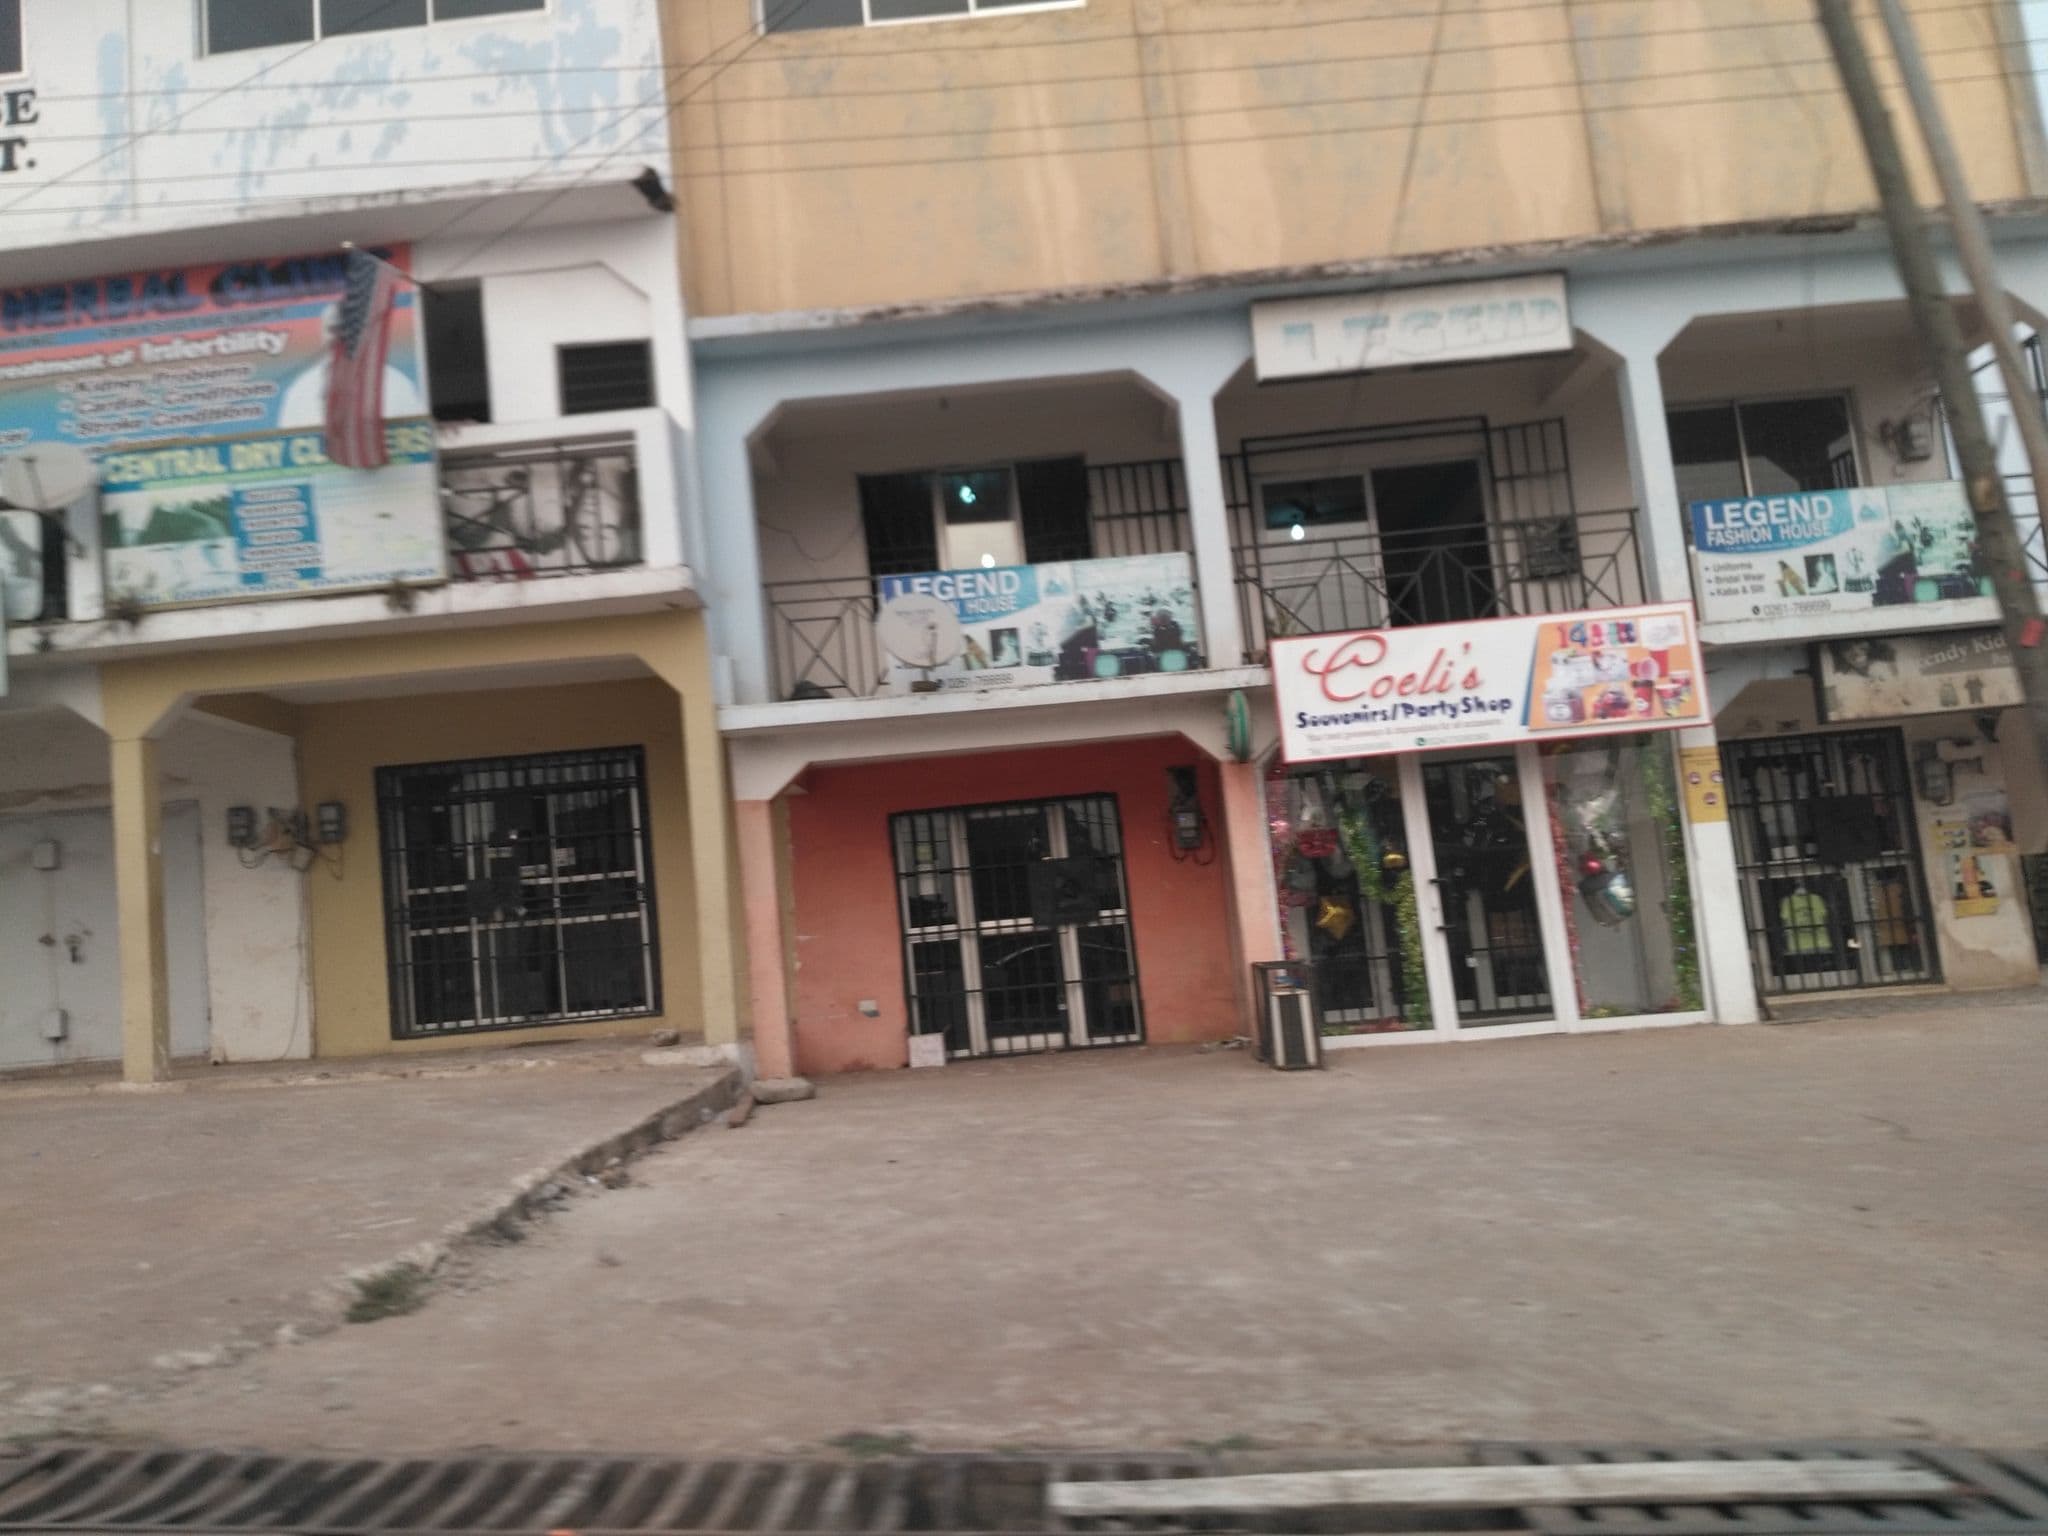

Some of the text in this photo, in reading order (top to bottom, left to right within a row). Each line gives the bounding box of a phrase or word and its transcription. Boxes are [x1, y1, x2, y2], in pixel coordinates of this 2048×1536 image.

[0, 89, 39, 125] E
[140, 331, 288, 364] Infertility
[104, 446, 226, 484] CENTRAL
[229, 440, 285, 470] DRY
[1704, 495, 1833, 531] LEGEND
[1707, 520, 1832, 547] FASHION HOUSE
[893, 570, 1020, 601] LEGEND
[964, 595, 1018, 614] HOUSE
[1301, 634, 1484, 702] Coeli's
